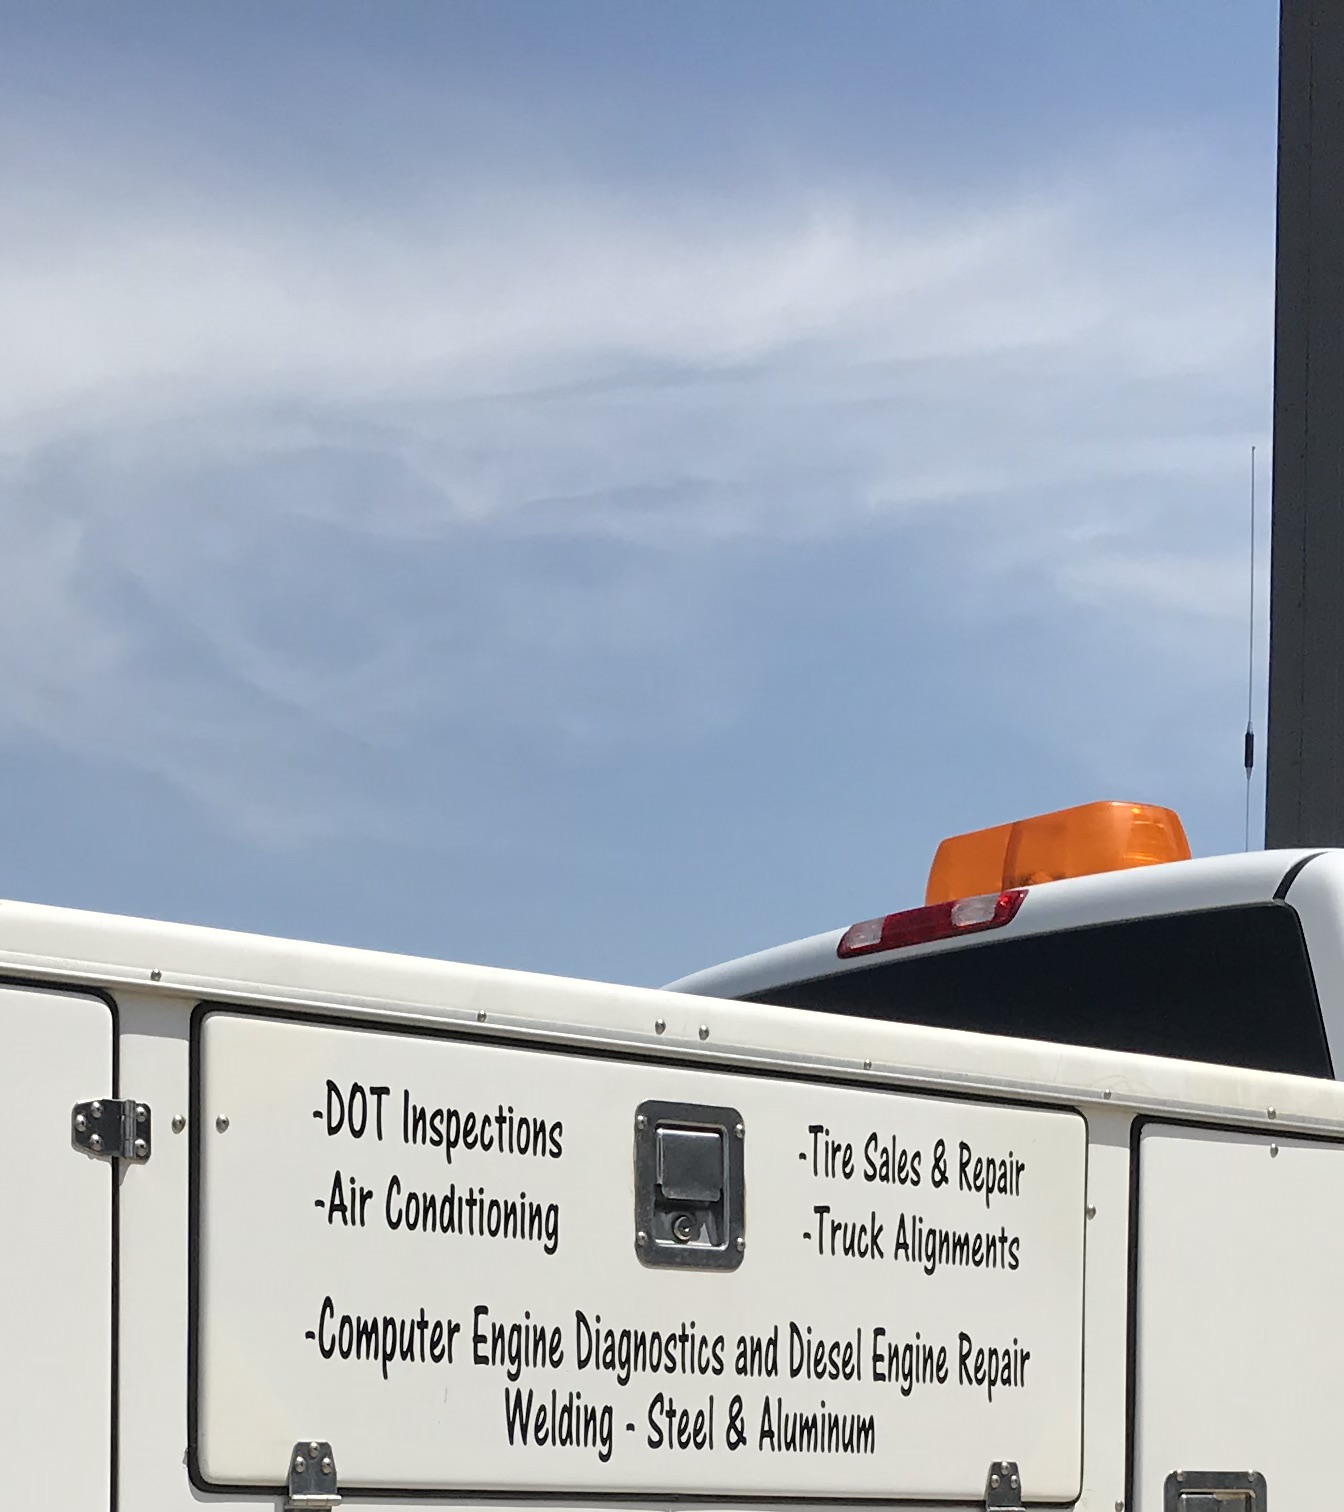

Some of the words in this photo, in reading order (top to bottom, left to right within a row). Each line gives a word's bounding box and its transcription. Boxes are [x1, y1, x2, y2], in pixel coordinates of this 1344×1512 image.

[312, 1079, 391, 1142] -DOT
[403, 1088, 564, 1165] Inspections
[798, 1124, 855, 1180] -Tire
[863, 1131, 922, 1188] Sales
[931, 1138, 949, 1189] &
[958, 1140, 1026, 1201] Repair
[314, 1169, 375, 1228] -Air
[385, 1174, 559, 1256] Conditioning
[802, 1205, 885, 1260] -Truck
[894, 1212, 1020, 1276] Alignments
[304, 1295, 462, 1381] -Computer
[472, 1304, 564, 1382] Engine
[575, 1308, 726, 1387] Diagnostics
[734, 1324, 779, 1378] and
[789, 1321, 862, 1382] Diesel
[871, 1326, 950, 1397] Engine
[958, 1331, 1031, 1403] Repair
[504, 1386, 615, 1463] Welding
[647, 1391, 715, 1452] Steel
[725, 1394, 748, 1452] &
[758, 1395, 876, 1456] Aluminum
